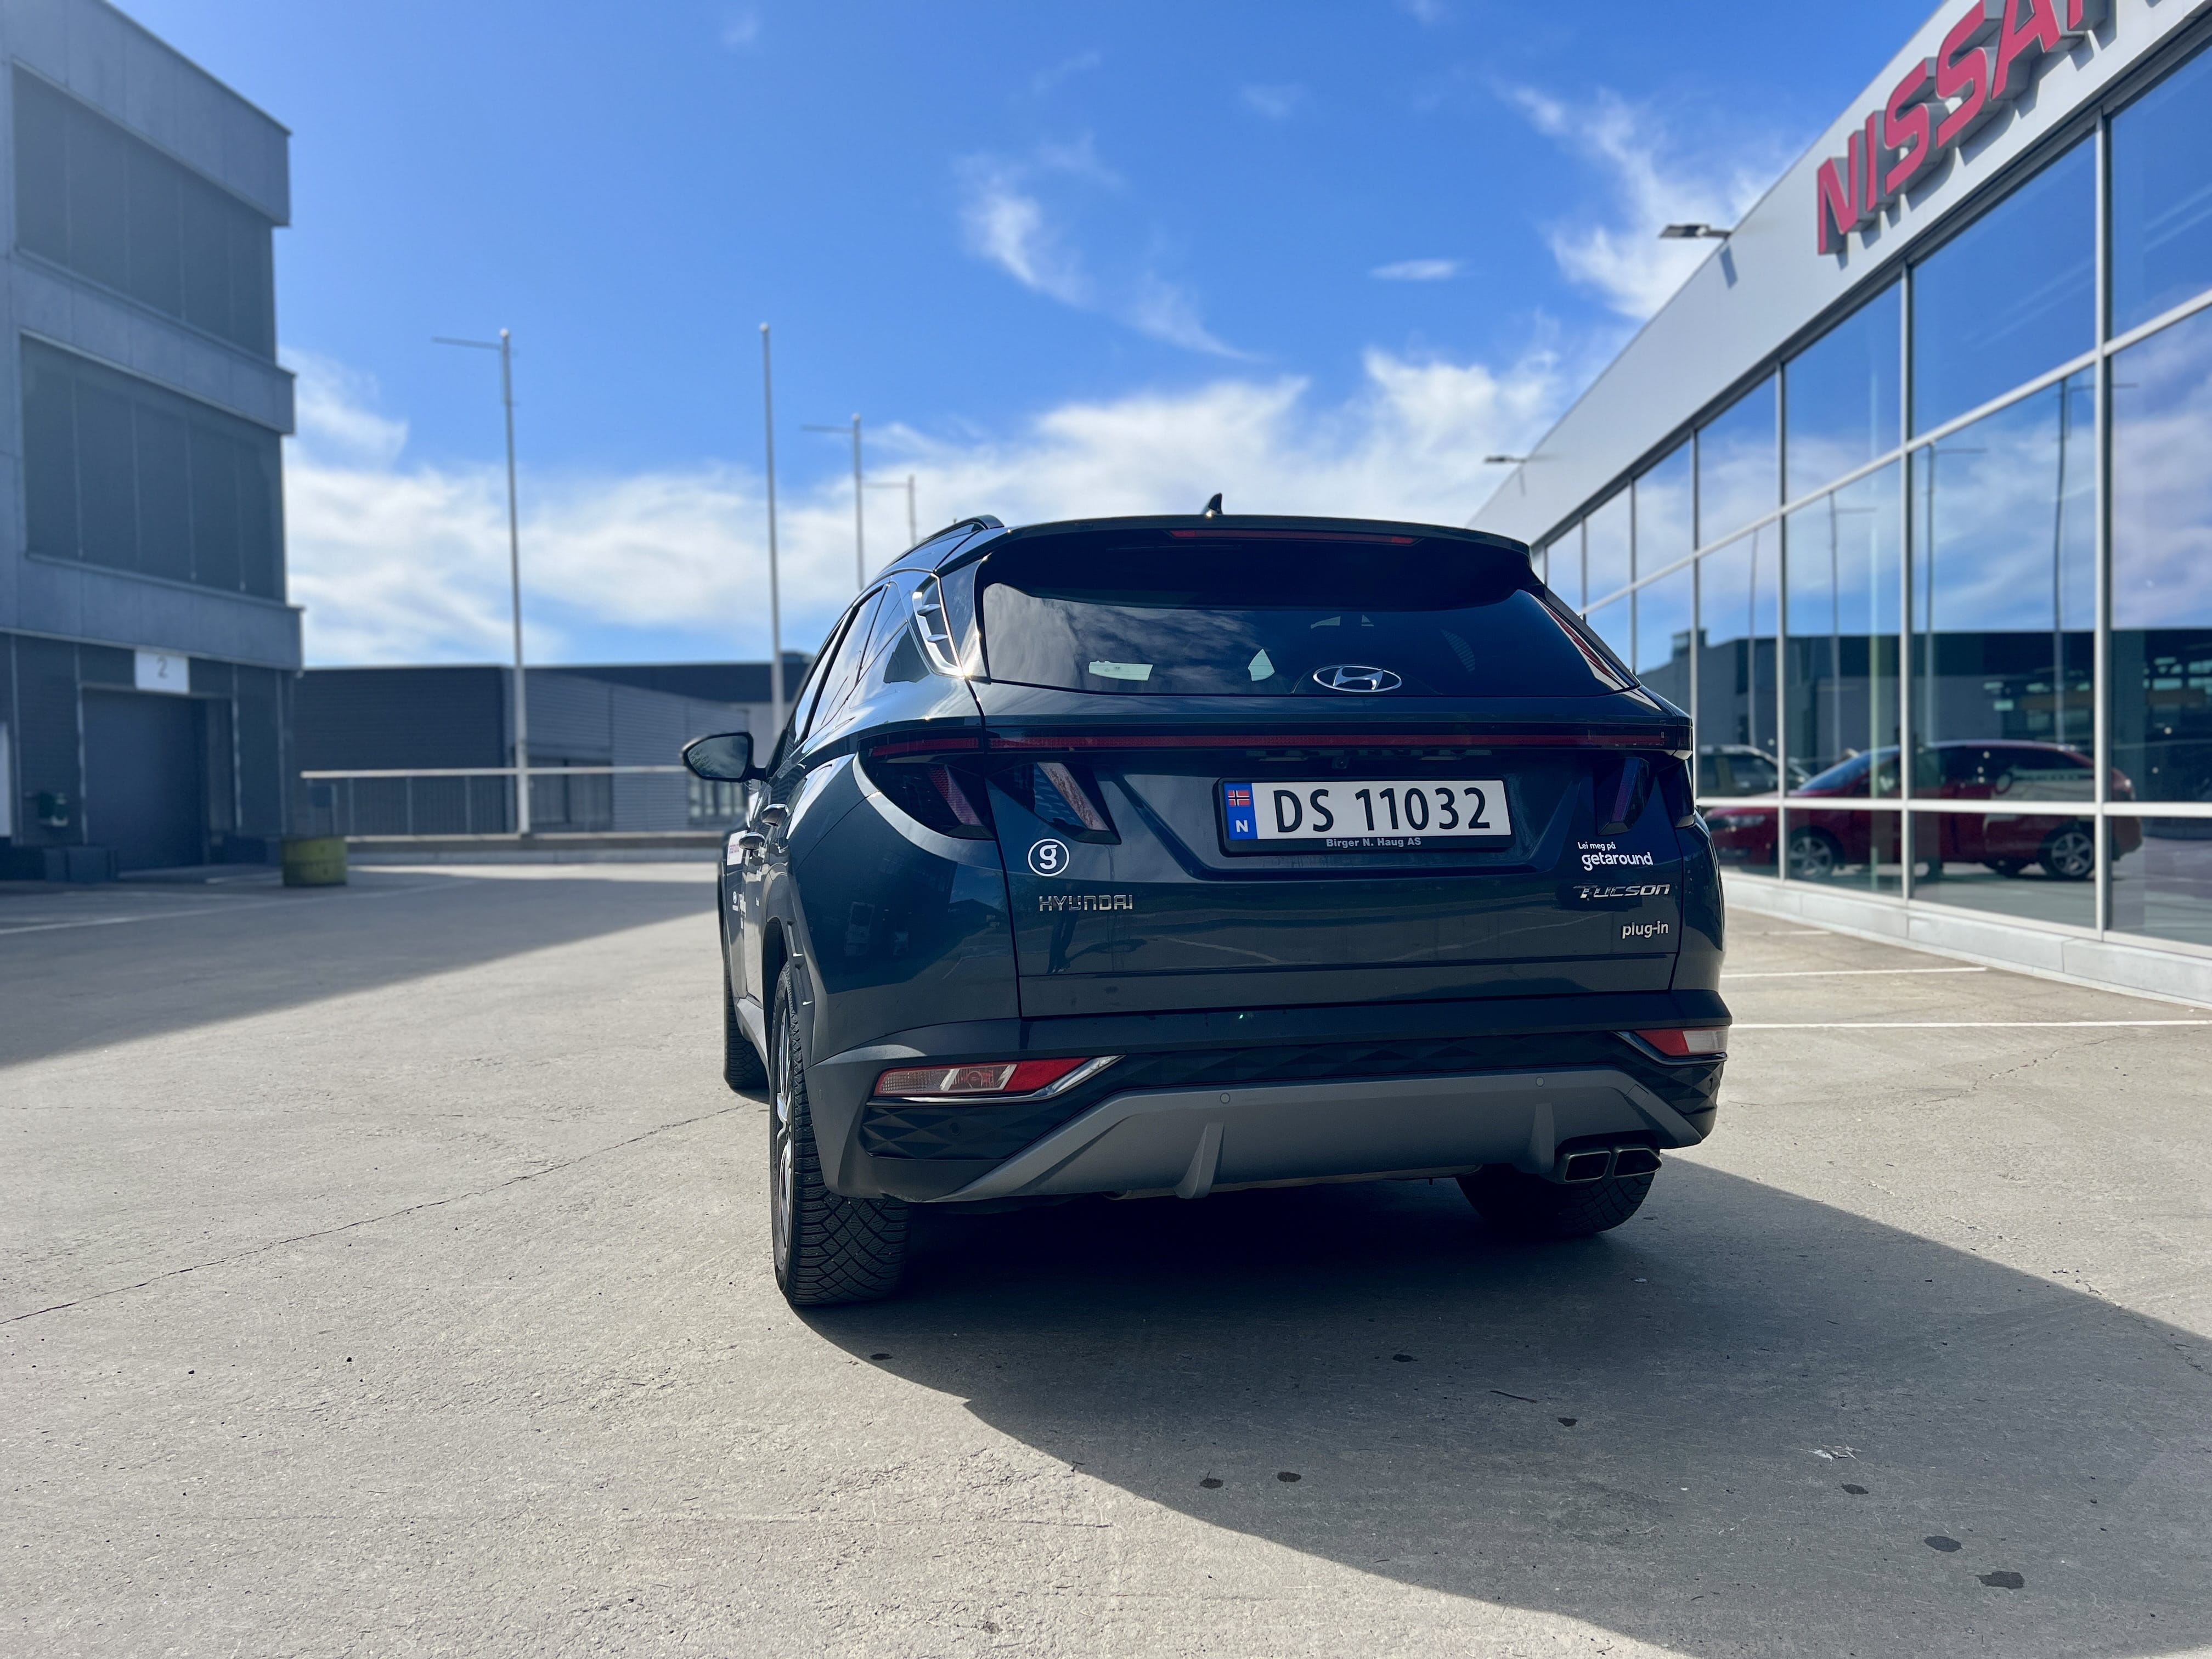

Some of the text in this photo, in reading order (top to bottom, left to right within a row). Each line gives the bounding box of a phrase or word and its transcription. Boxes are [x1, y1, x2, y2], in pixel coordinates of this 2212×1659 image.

[1818, 0, 2083, 255] NISSA
[157, 656, 168, 679] 2
[1273, 787, 1491, 833] DS 11032
[1235, 820, 1248, 833] N
[1325, 837, 1422, 849] Birger N. Haug AS
[1607, 842, 1616, 851] på
[1582, 852, 1654, 871] getaround
[1039, 894, 1133, 911] HYUNDAI
[1622, 920, 1669, 939] plug-in
